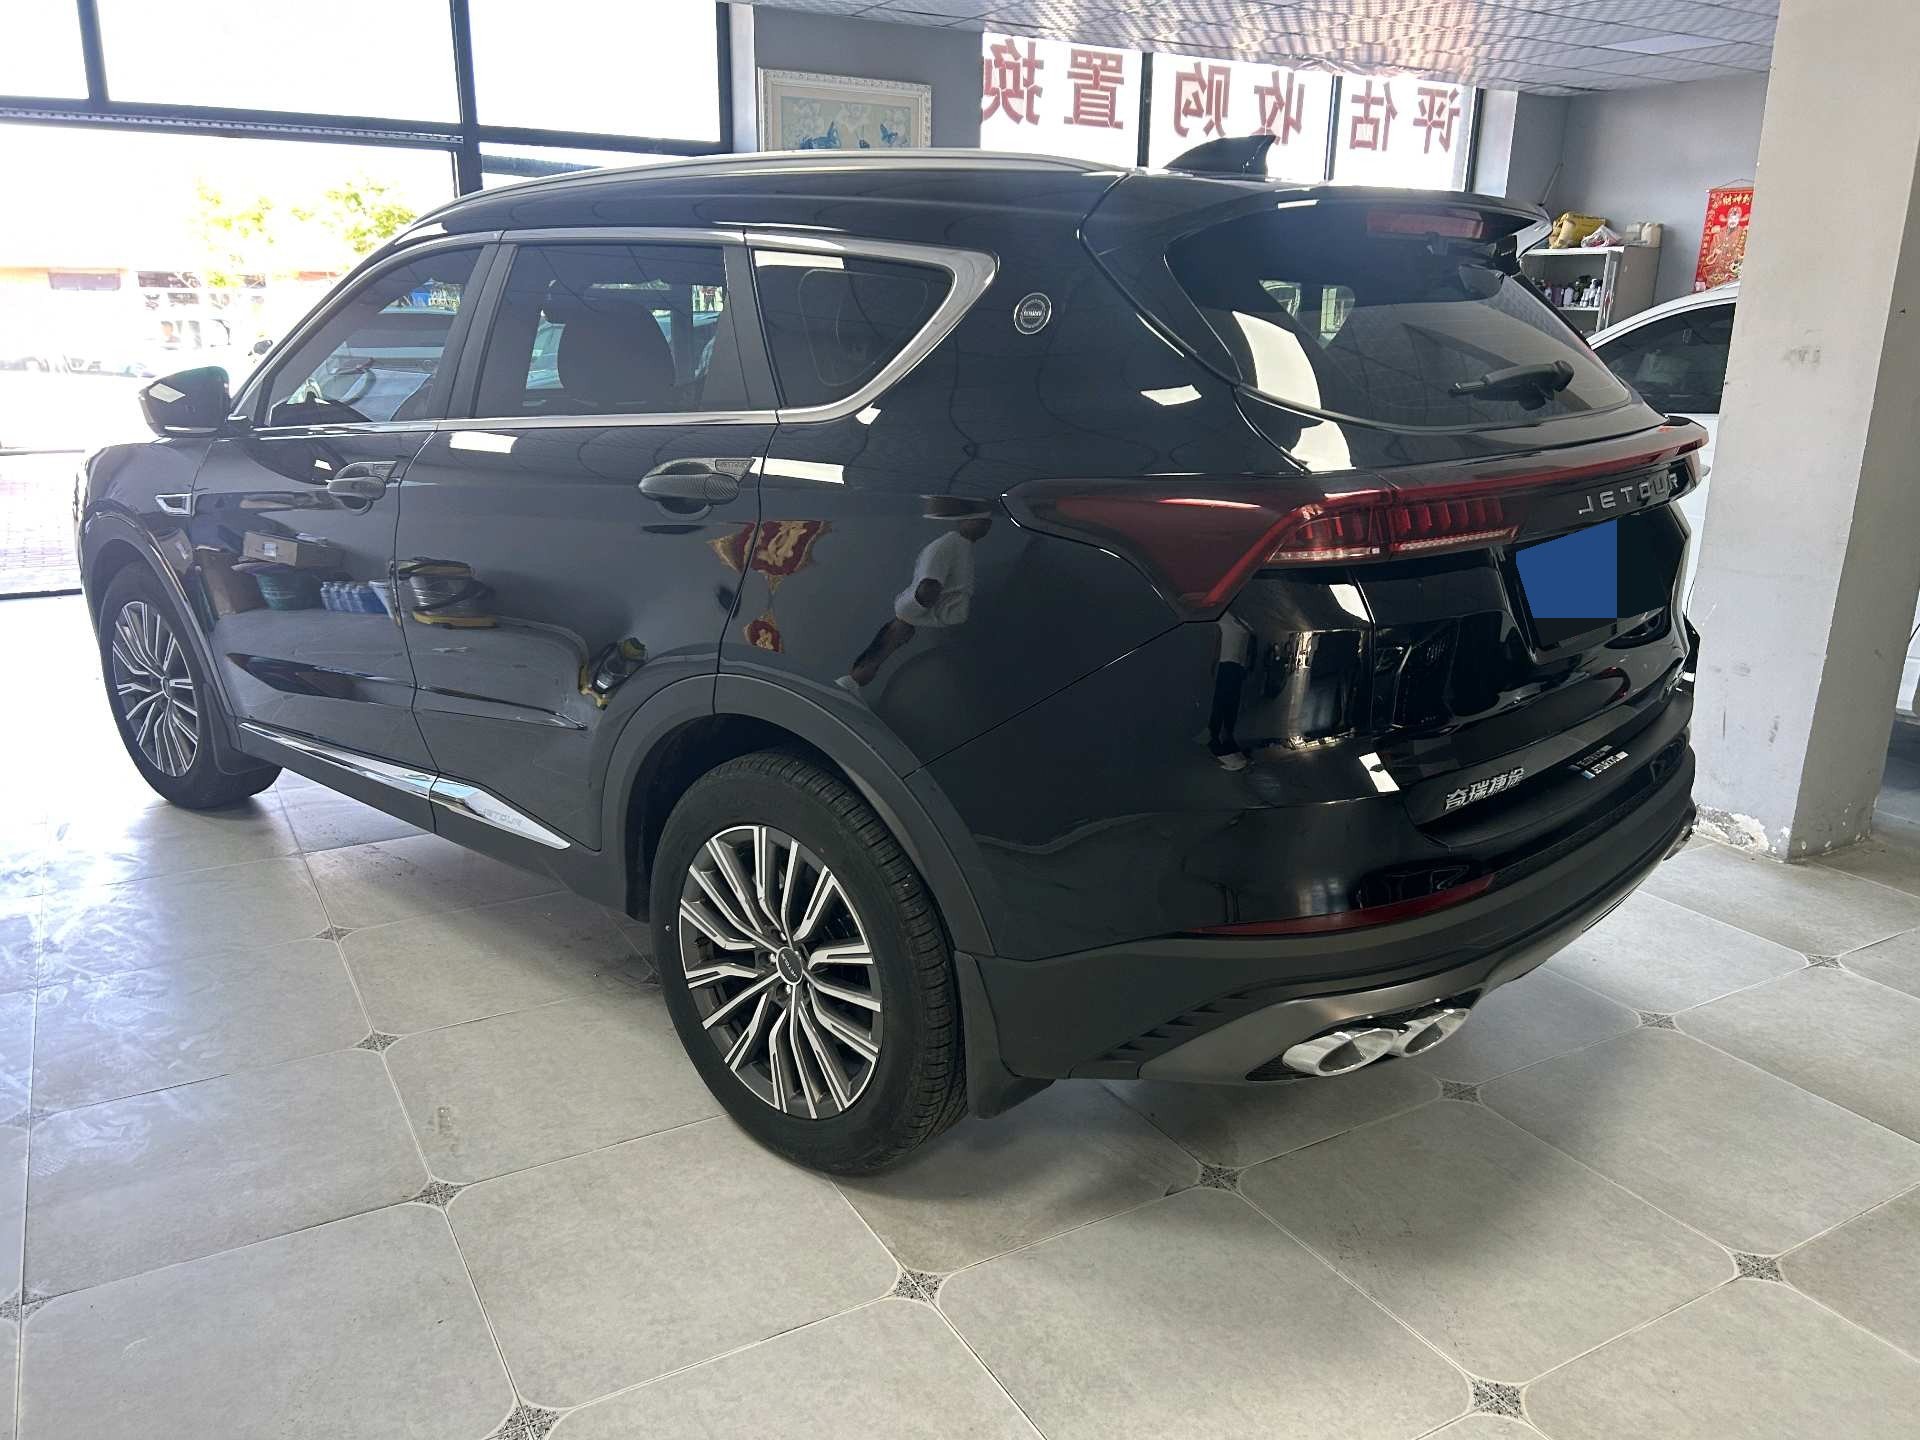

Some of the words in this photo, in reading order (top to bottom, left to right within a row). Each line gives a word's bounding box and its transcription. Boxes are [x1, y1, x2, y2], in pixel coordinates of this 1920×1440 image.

[1578, 472, 1679, 515] JETOUR
[1445, 767, 1525, 811] 奇瑞捷途
